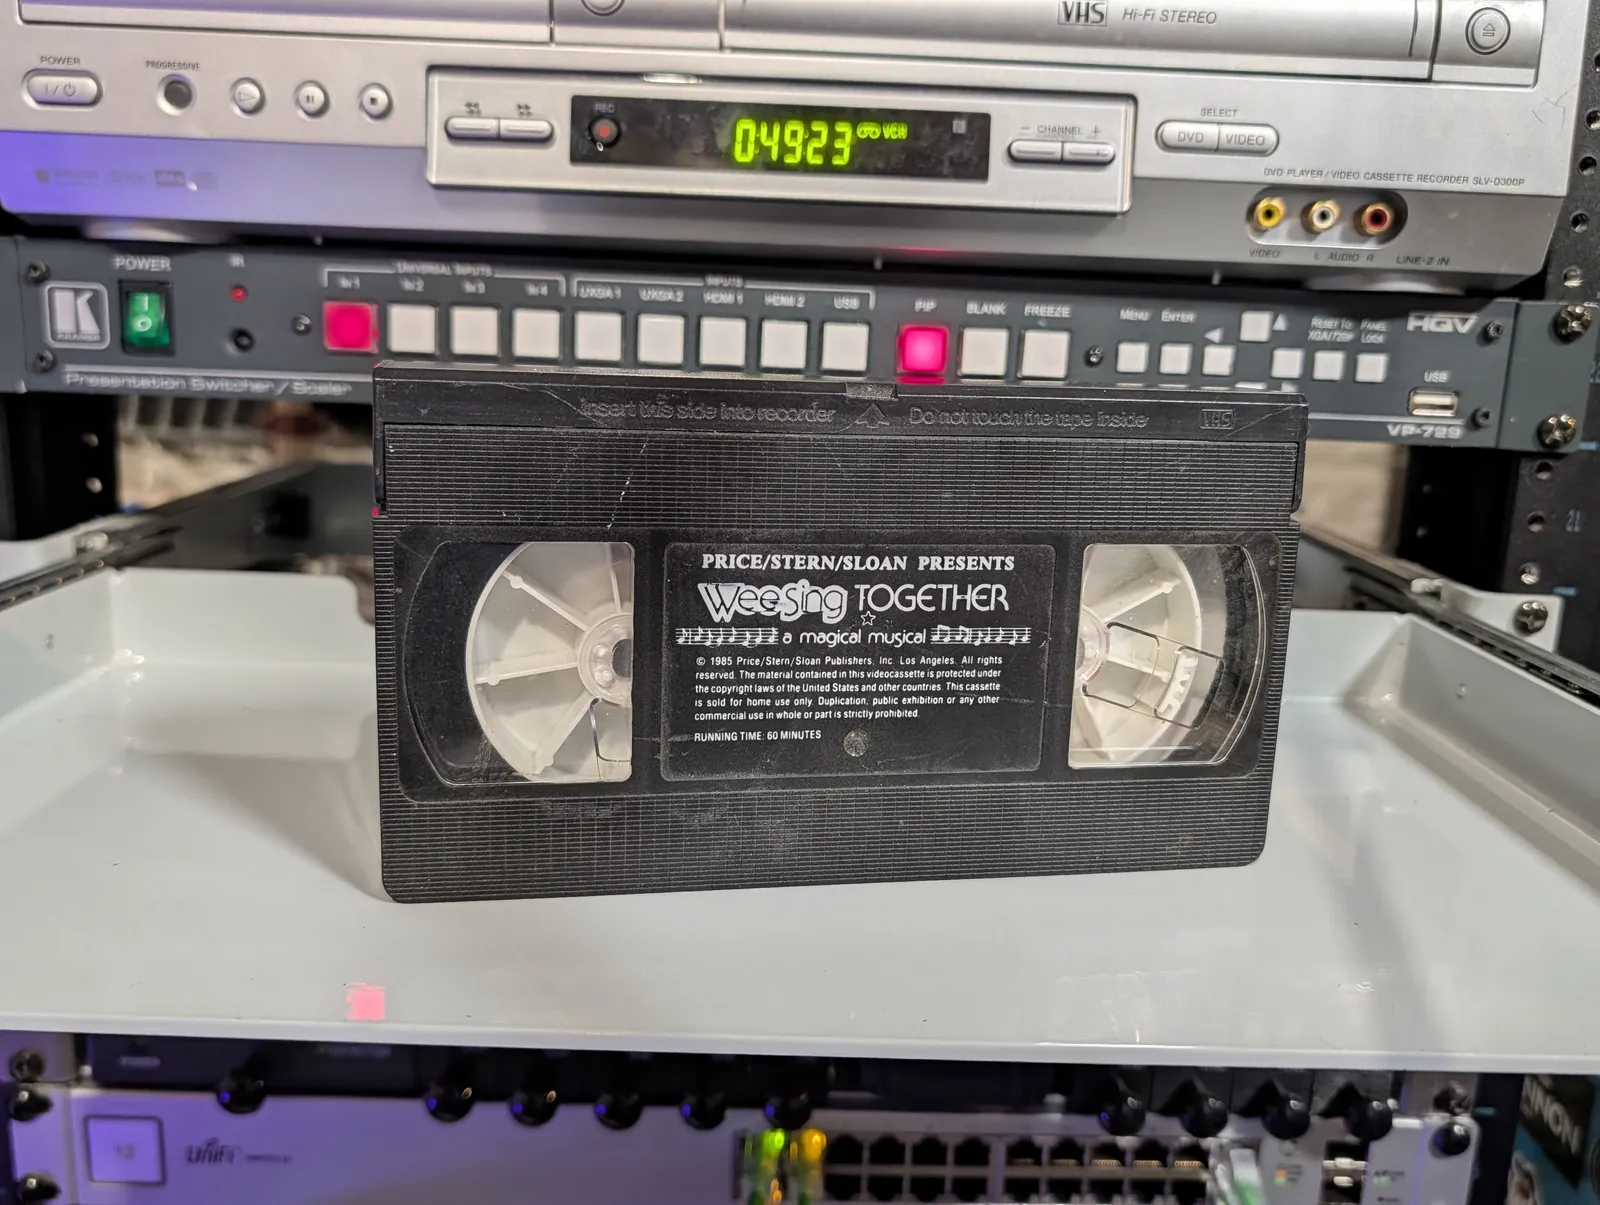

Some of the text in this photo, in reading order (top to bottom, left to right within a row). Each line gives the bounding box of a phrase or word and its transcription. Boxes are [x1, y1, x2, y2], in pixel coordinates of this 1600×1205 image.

[1062, 1, 1105, 24] VHS
[1122, 8, 1217, 24] Hi-Fi STEREO
[40, 55, 81, 66] POWER
[145, 59, 200, 72] PROGRESSIVE
[1200, 108, 1238, 118] SELECT
[1037, 124, 1083, 135] CHANNEL
[1177, 132, 1204, 144] DVD
[1225, 133, 1266, 147] VIDEO
[1263, 168, 1283, 177] DVD
[1363, 172, 1414, 183] CASSETTE
[1416, 173, 1469, 185] RECORDER
[1249, 249, 1281, 259] VIDEO
[1327, 253, 1360, 262] AUDIO
[1437, 256, 1450, 266] IN
[114, 255, 172, 271] POWER
[833, 296, 860, 310] USB
[915, 300, 937, 312] PIP
[966, 301, 1007, 315] BLANK
[1024, 303, 1072, 317] FREEZE
[1120, 307, 1151, 321] MENU
[1161, 309, 1197, 323] ENTER
[1407, 312, 1478, 333] HQV
[1424, 370, 1450, 383] USB
[639, 400, 675, 419] this
[677, 402, 717, 420] side
[720, 403, 757, 421] into
[757, 402, 836, 424] recorder
[909, 406, 1149, 430] Do not touch the tape inside
[701, 554, 1015, 572] PRICE/STERN/SLOAN PRESENTS
[854, 583, 1010, 612] TOGETHER
[782, 628, 927, 648] a magical musical
[710, 656, 733, 666] 1985
[736, 656, 821, 667] Price/Stern/Sloan
[900, 655, 916, 665] Los
[919, 655, 957, 666] Angeles.
[961, 655, 974, 665] All
[977, 655, 1003, 667] rights
[695, 669, 1002, 680] reserved. The material contained in this videocassette is protected under
[695, 684, 709, 693] the
[710, 684, 753, 695] copyright
[754, 683, 775, 693] laws
[776, 683, 786, 693] of
[787, 683, 801, 693] the
[802, 683, 830, 692] United
[832, 682, 859, 692] States
[861, 683, 877, 692] and
[878, 682, 901, 691] other
[946, 681, 964, 691] This
[965, 682, 1001, 691] cassette
[694, 698, 703, 707] is
[706, 697, 726, 707] sold
[729, 697, 743, 707] for
[746, 697, 771, 707] home
[774, 698, 790, 707] use
[872, 695, 899, 706] public
[901, 695, 944, 705] exhibition
[946, 696, 956, 704] or
[959, 697, 975, 706] any
[977, 695, 1000, 704] other
[694, 711, 747, 721] commercial
[748, 712, 764, 720] use
[765, 711, 774, 720] in
[776, 710, 802, 720] whole
[803, 711, 813, 719] or
[814, 710, 832, 721] part
[833, 710, 842, 719] is
[843, 709, 874, 720] strictly
[694, 731, 738, 742] RUNNING
[767, 730, 779, 741] 60
[780, 730, 822, 740] MINUTES
